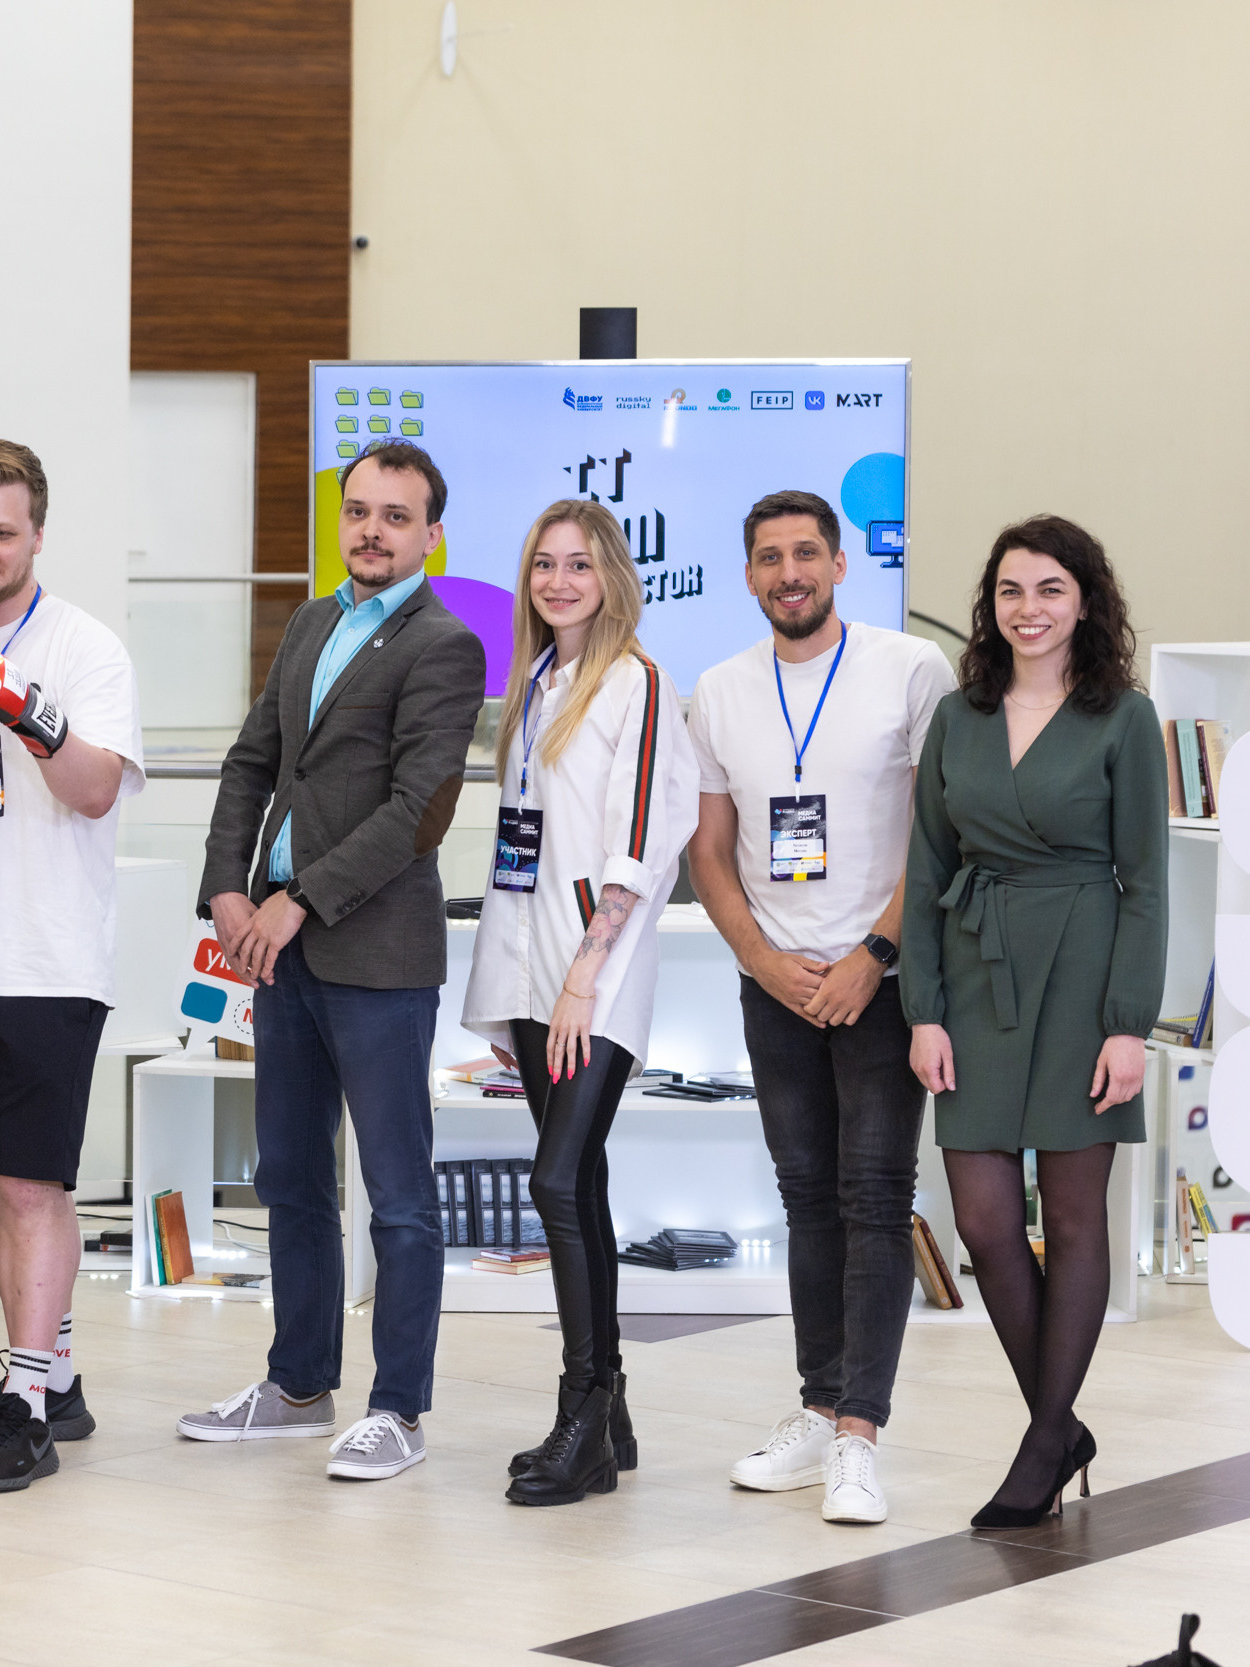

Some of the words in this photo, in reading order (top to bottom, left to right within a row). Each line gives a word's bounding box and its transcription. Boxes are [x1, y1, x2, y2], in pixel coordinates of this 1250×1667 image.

[577, 395, 603, 403] ДВФУ
[756, 395, 789, 405] FEIP
[780, 828, 817, 838] ЭКСПЕРТ
[500, 845, 537, 857] УЧАСТНИК
[53, 1349, 70, 1357] VE
